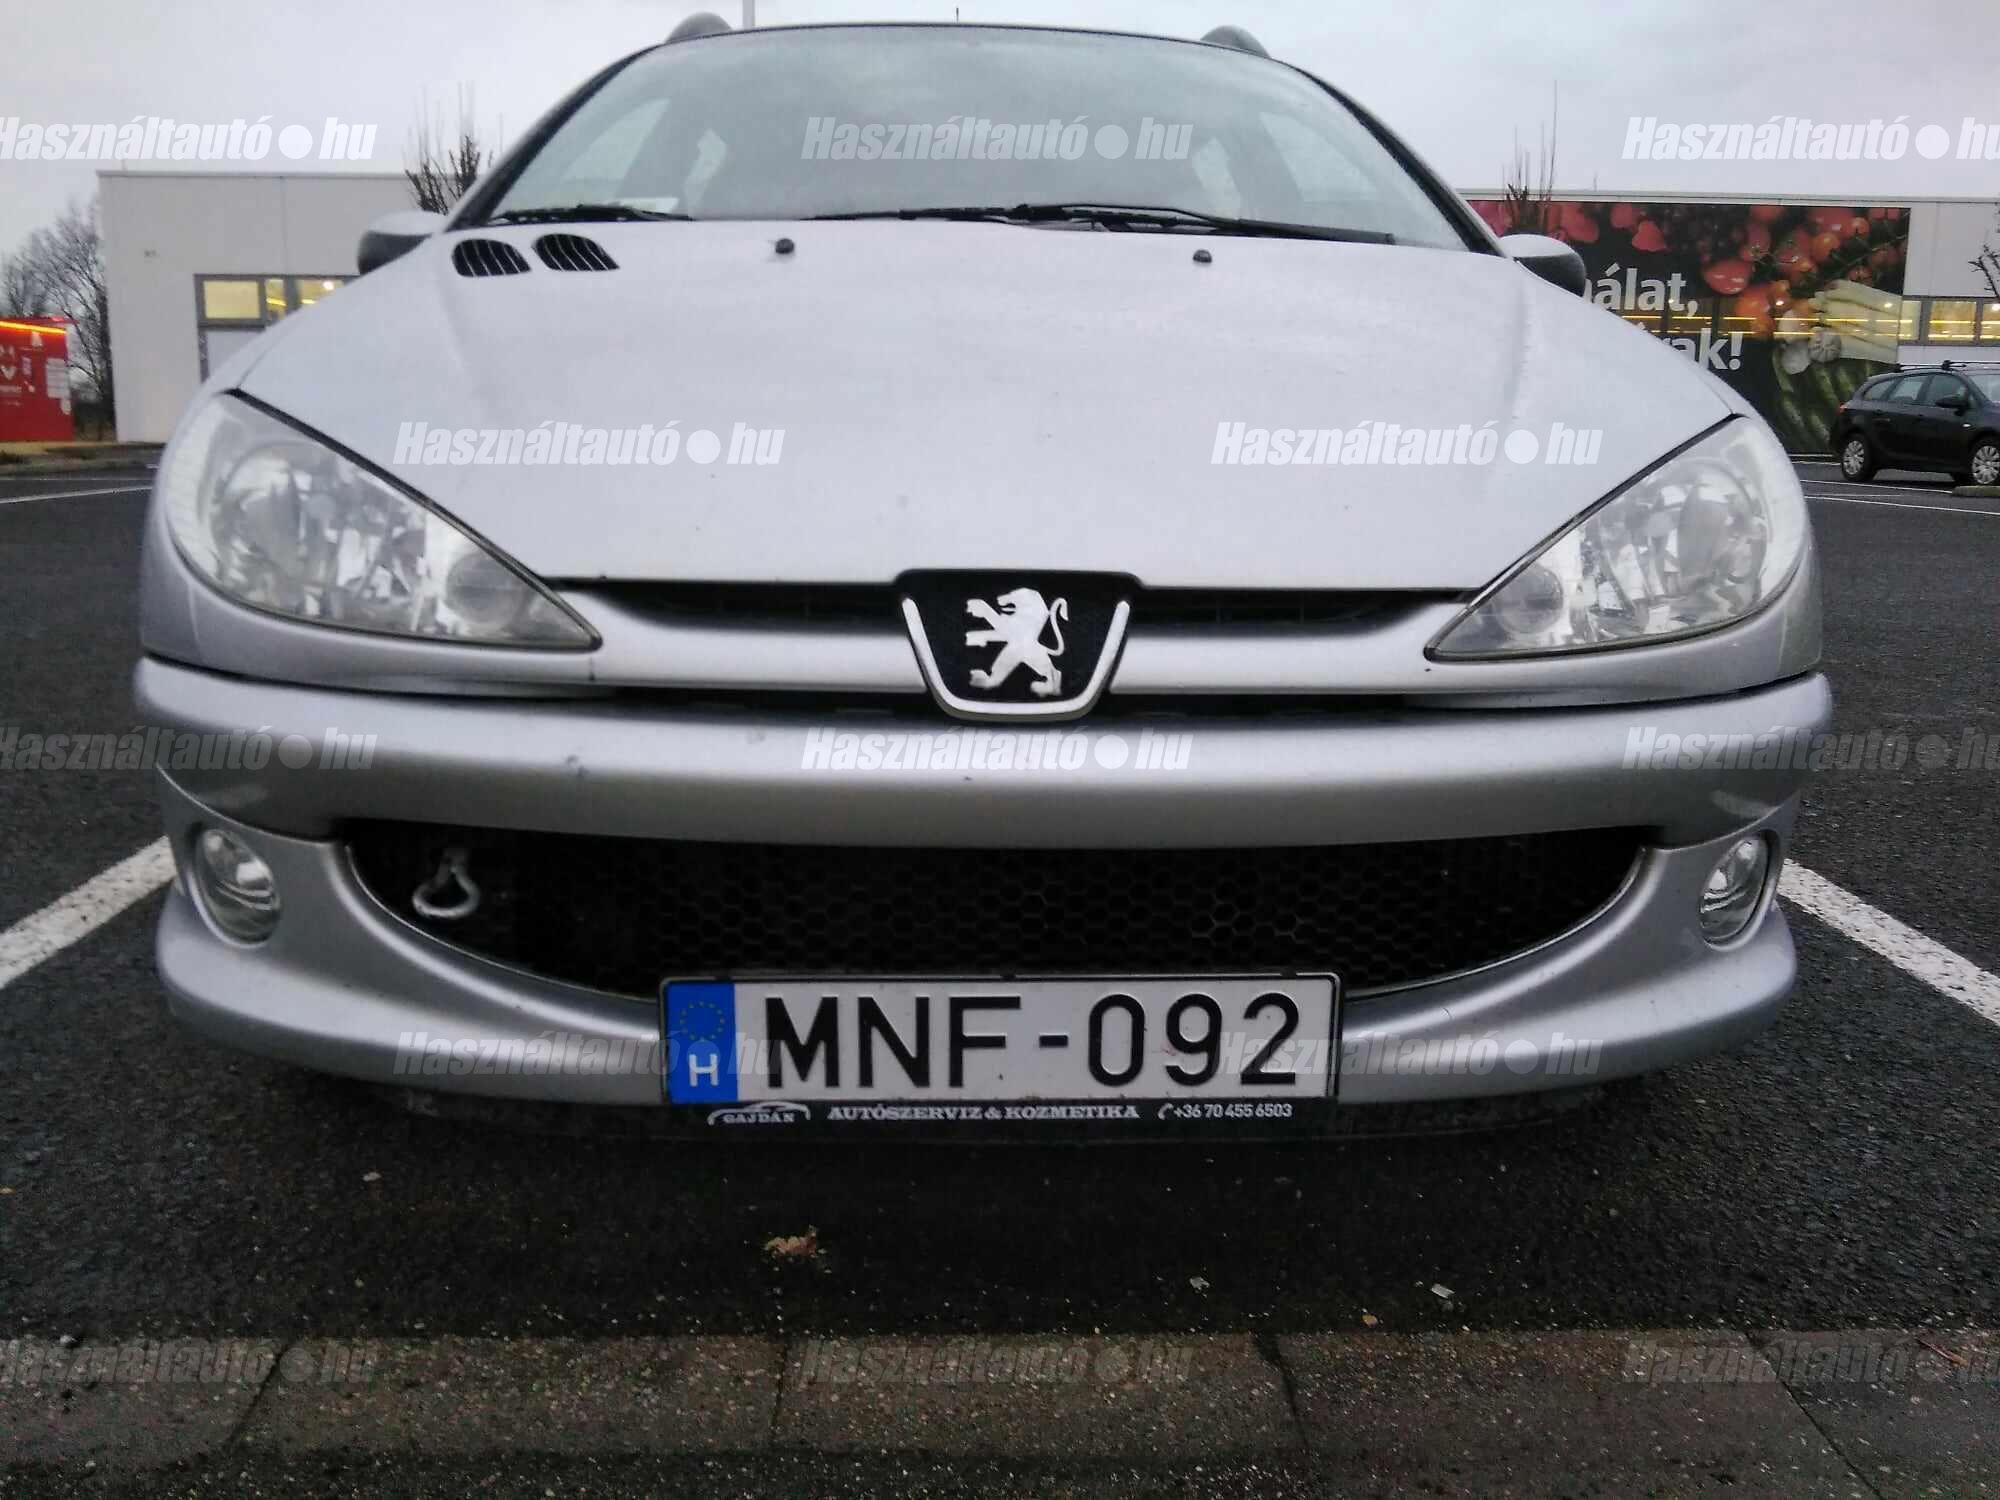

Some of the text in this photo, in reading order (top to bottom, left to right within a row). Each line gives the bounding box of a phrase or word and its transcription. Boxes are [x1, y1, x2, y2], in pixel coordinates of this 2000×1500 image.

[765, 992, 1299, 1088] MNF-092
[689, 1054, 718, 1086] H
[827, 1104, 983, 1120] AUTÓSZERVIZ
[1005, 1105, 1139, 1119] KOZMETIKA
[1174, 1103, 1293, 1118] +36 70 455 6503
